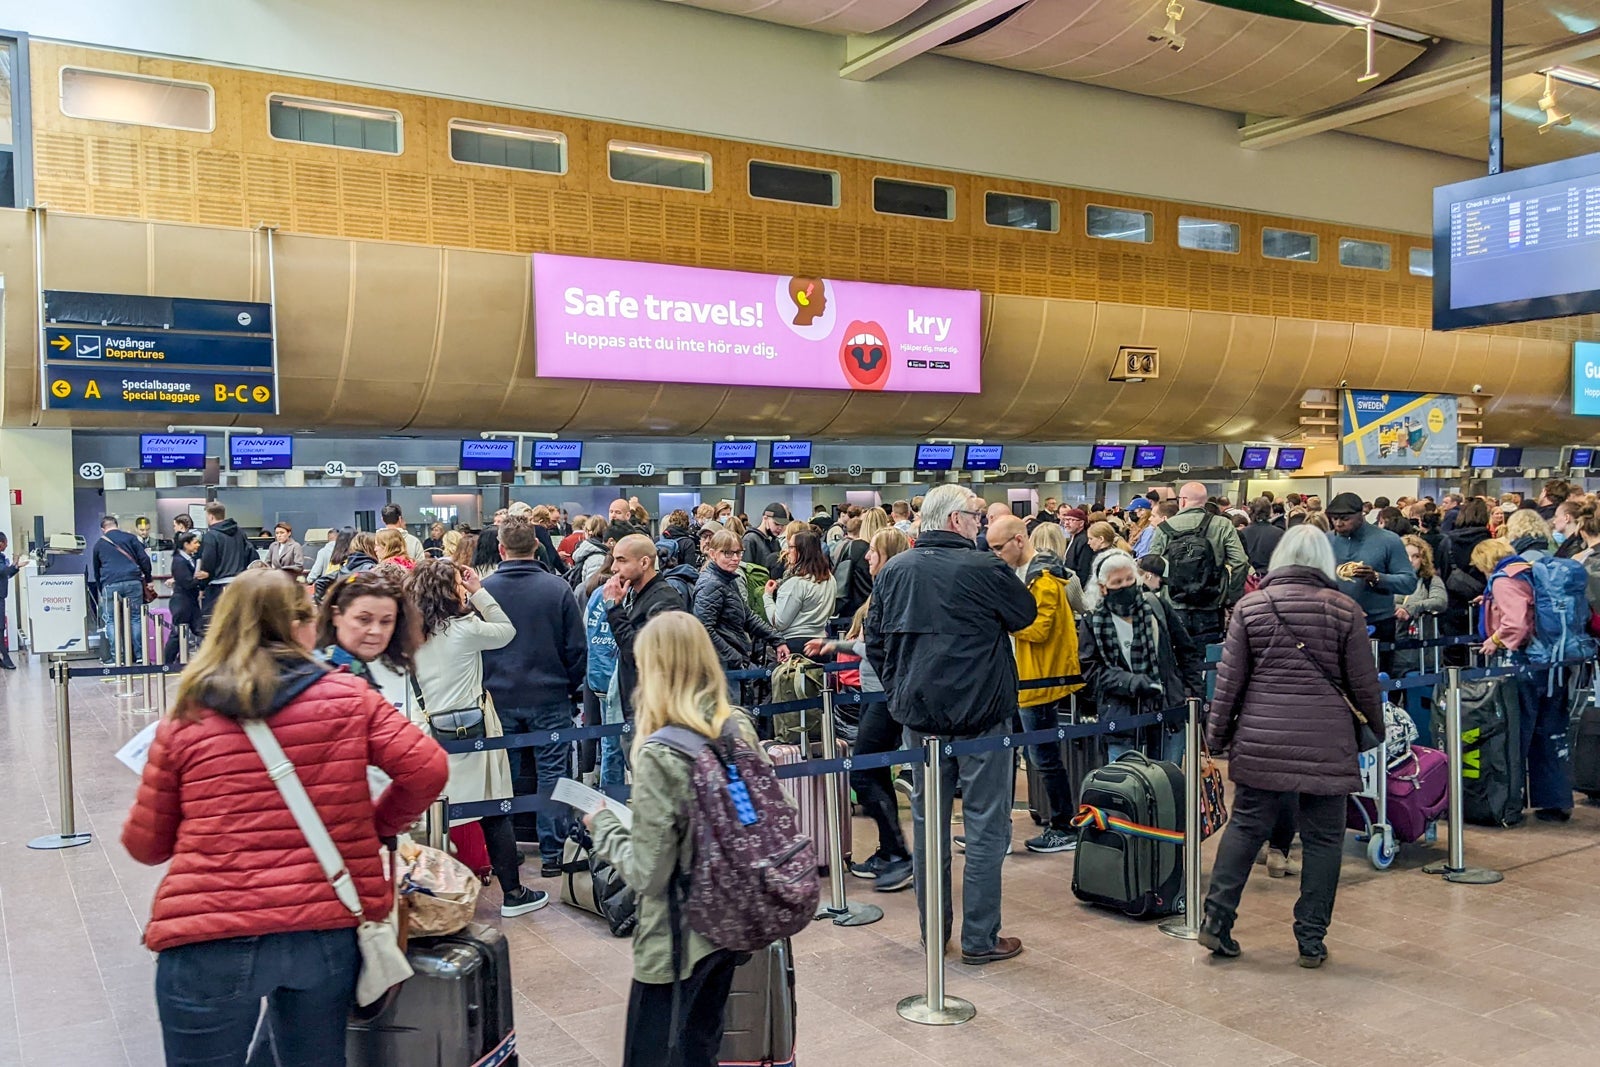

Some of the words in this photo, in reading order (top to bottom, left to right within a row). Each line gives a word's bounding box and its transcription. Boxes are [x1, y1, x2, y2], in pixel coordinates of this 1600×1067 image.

[564, 287, 639, 319] Safe
[644, 294, 764, 328] travels!
[908, 309, 952, 342] kry
[106, 337, 155, 349] Avgångar
[565, 332, 625, 350] Hoppas
[628, 336, 651, 350] att
[655, 338, 674, 351] du
[677, 339, 704, 352] inte
[708, 340, 731, 354] hör
[734, 345, 750, 355] av
[753, 343, 778, 359] dig.
[106, 348, 164, 360] Departures
[84, 380, 101, 398] A
[122, 380, 191, 391] Specialbagage
[123, 390, 157, 401] Special
[160, 392, 200, 403] baggage
[214, 384, 248, 403] B-C
[1358, 401, 1384, 410] SWEDEN
[82, 465, 102, 477] 33
[327, 464, 344, 474] 34
[381, 464, 396, 474] 35
[598, 465, 611, 474] 36
[641, 465, 652, 474] 37
[815, 465, 826, 475] 38
[850, 465, 860, 474] 39
[1027, 464, 1036, 473] 41
[1179, 464, 1188, 472] 43
[588, 600, 606, 627] HAV
